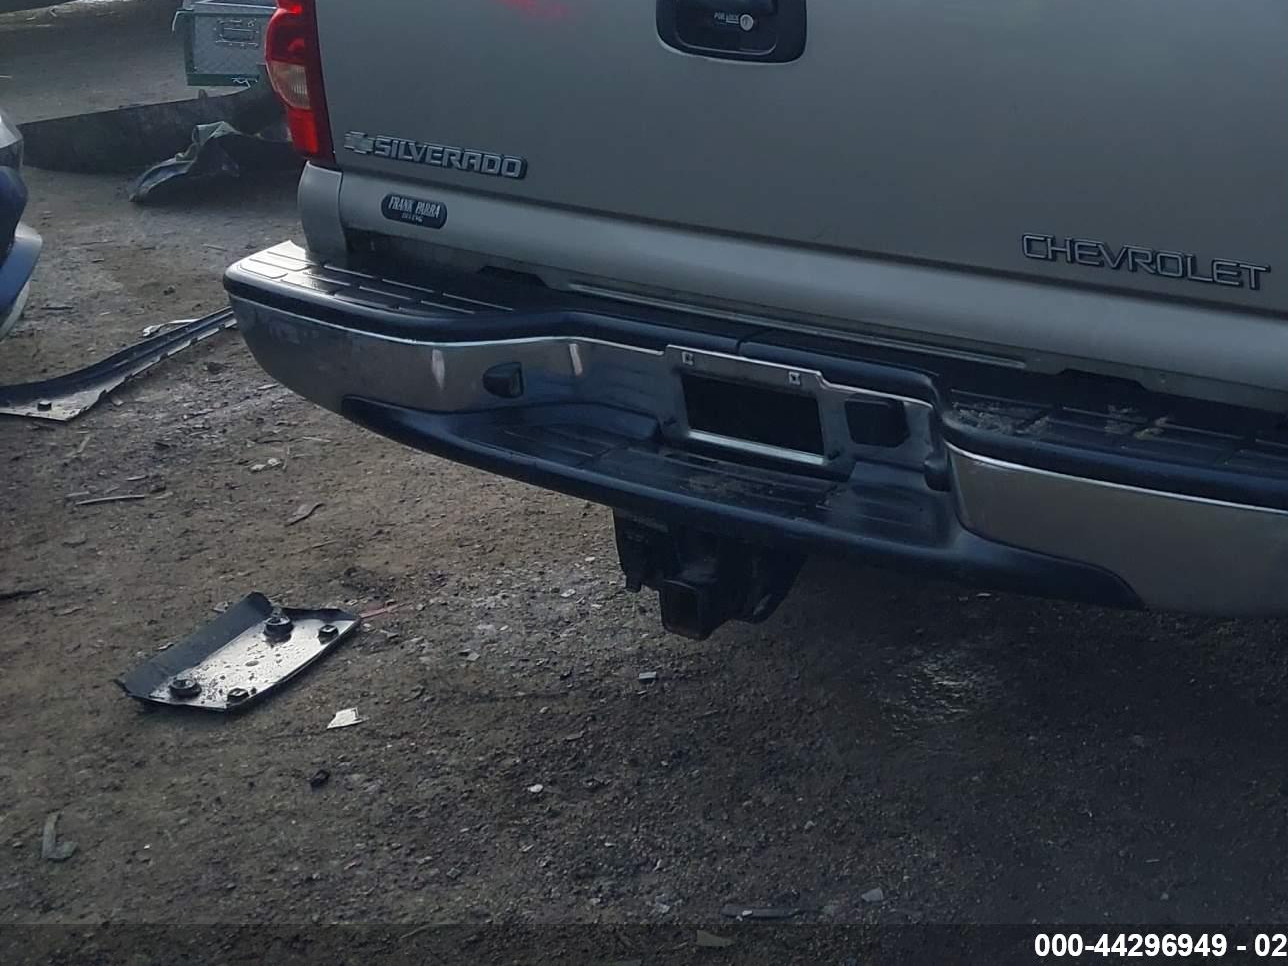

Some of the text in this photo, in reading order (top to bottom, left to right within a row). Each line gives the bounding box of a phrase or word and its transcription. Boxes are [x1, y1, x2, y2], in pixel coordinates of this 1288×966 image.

[373, 135, 525, 179] SILVERADO
[388, 195, 414, 213] FRANK
[1022, 232, 1271, 290] CHEVROLET
